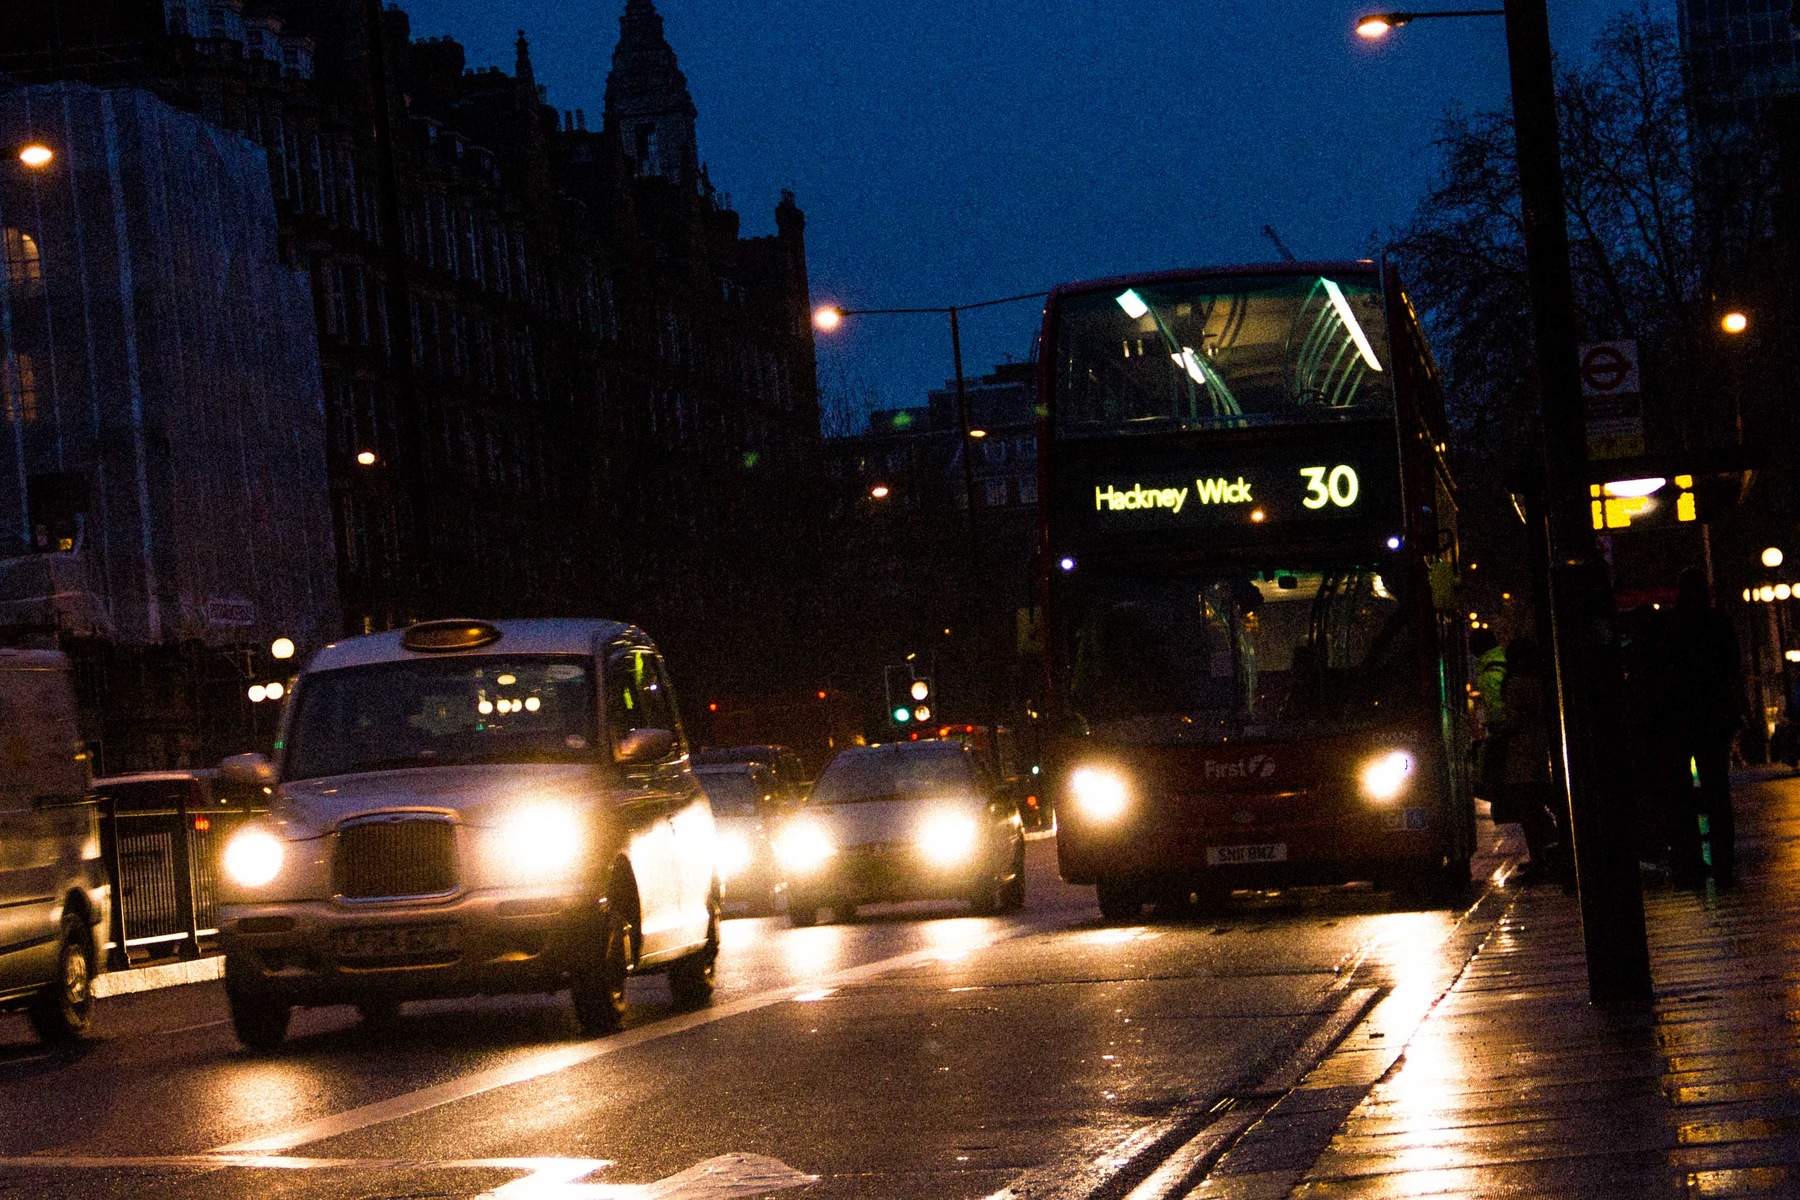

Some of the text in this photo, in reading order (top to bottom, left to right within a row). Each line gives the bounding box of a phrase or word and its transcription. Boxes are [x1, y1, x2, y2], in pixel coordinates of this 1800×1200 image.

[1095, 477, 1253, 513] Hackney Wick
[1300, 464, 1359, 509] 30
[1204, 758, 1247, 779] First
